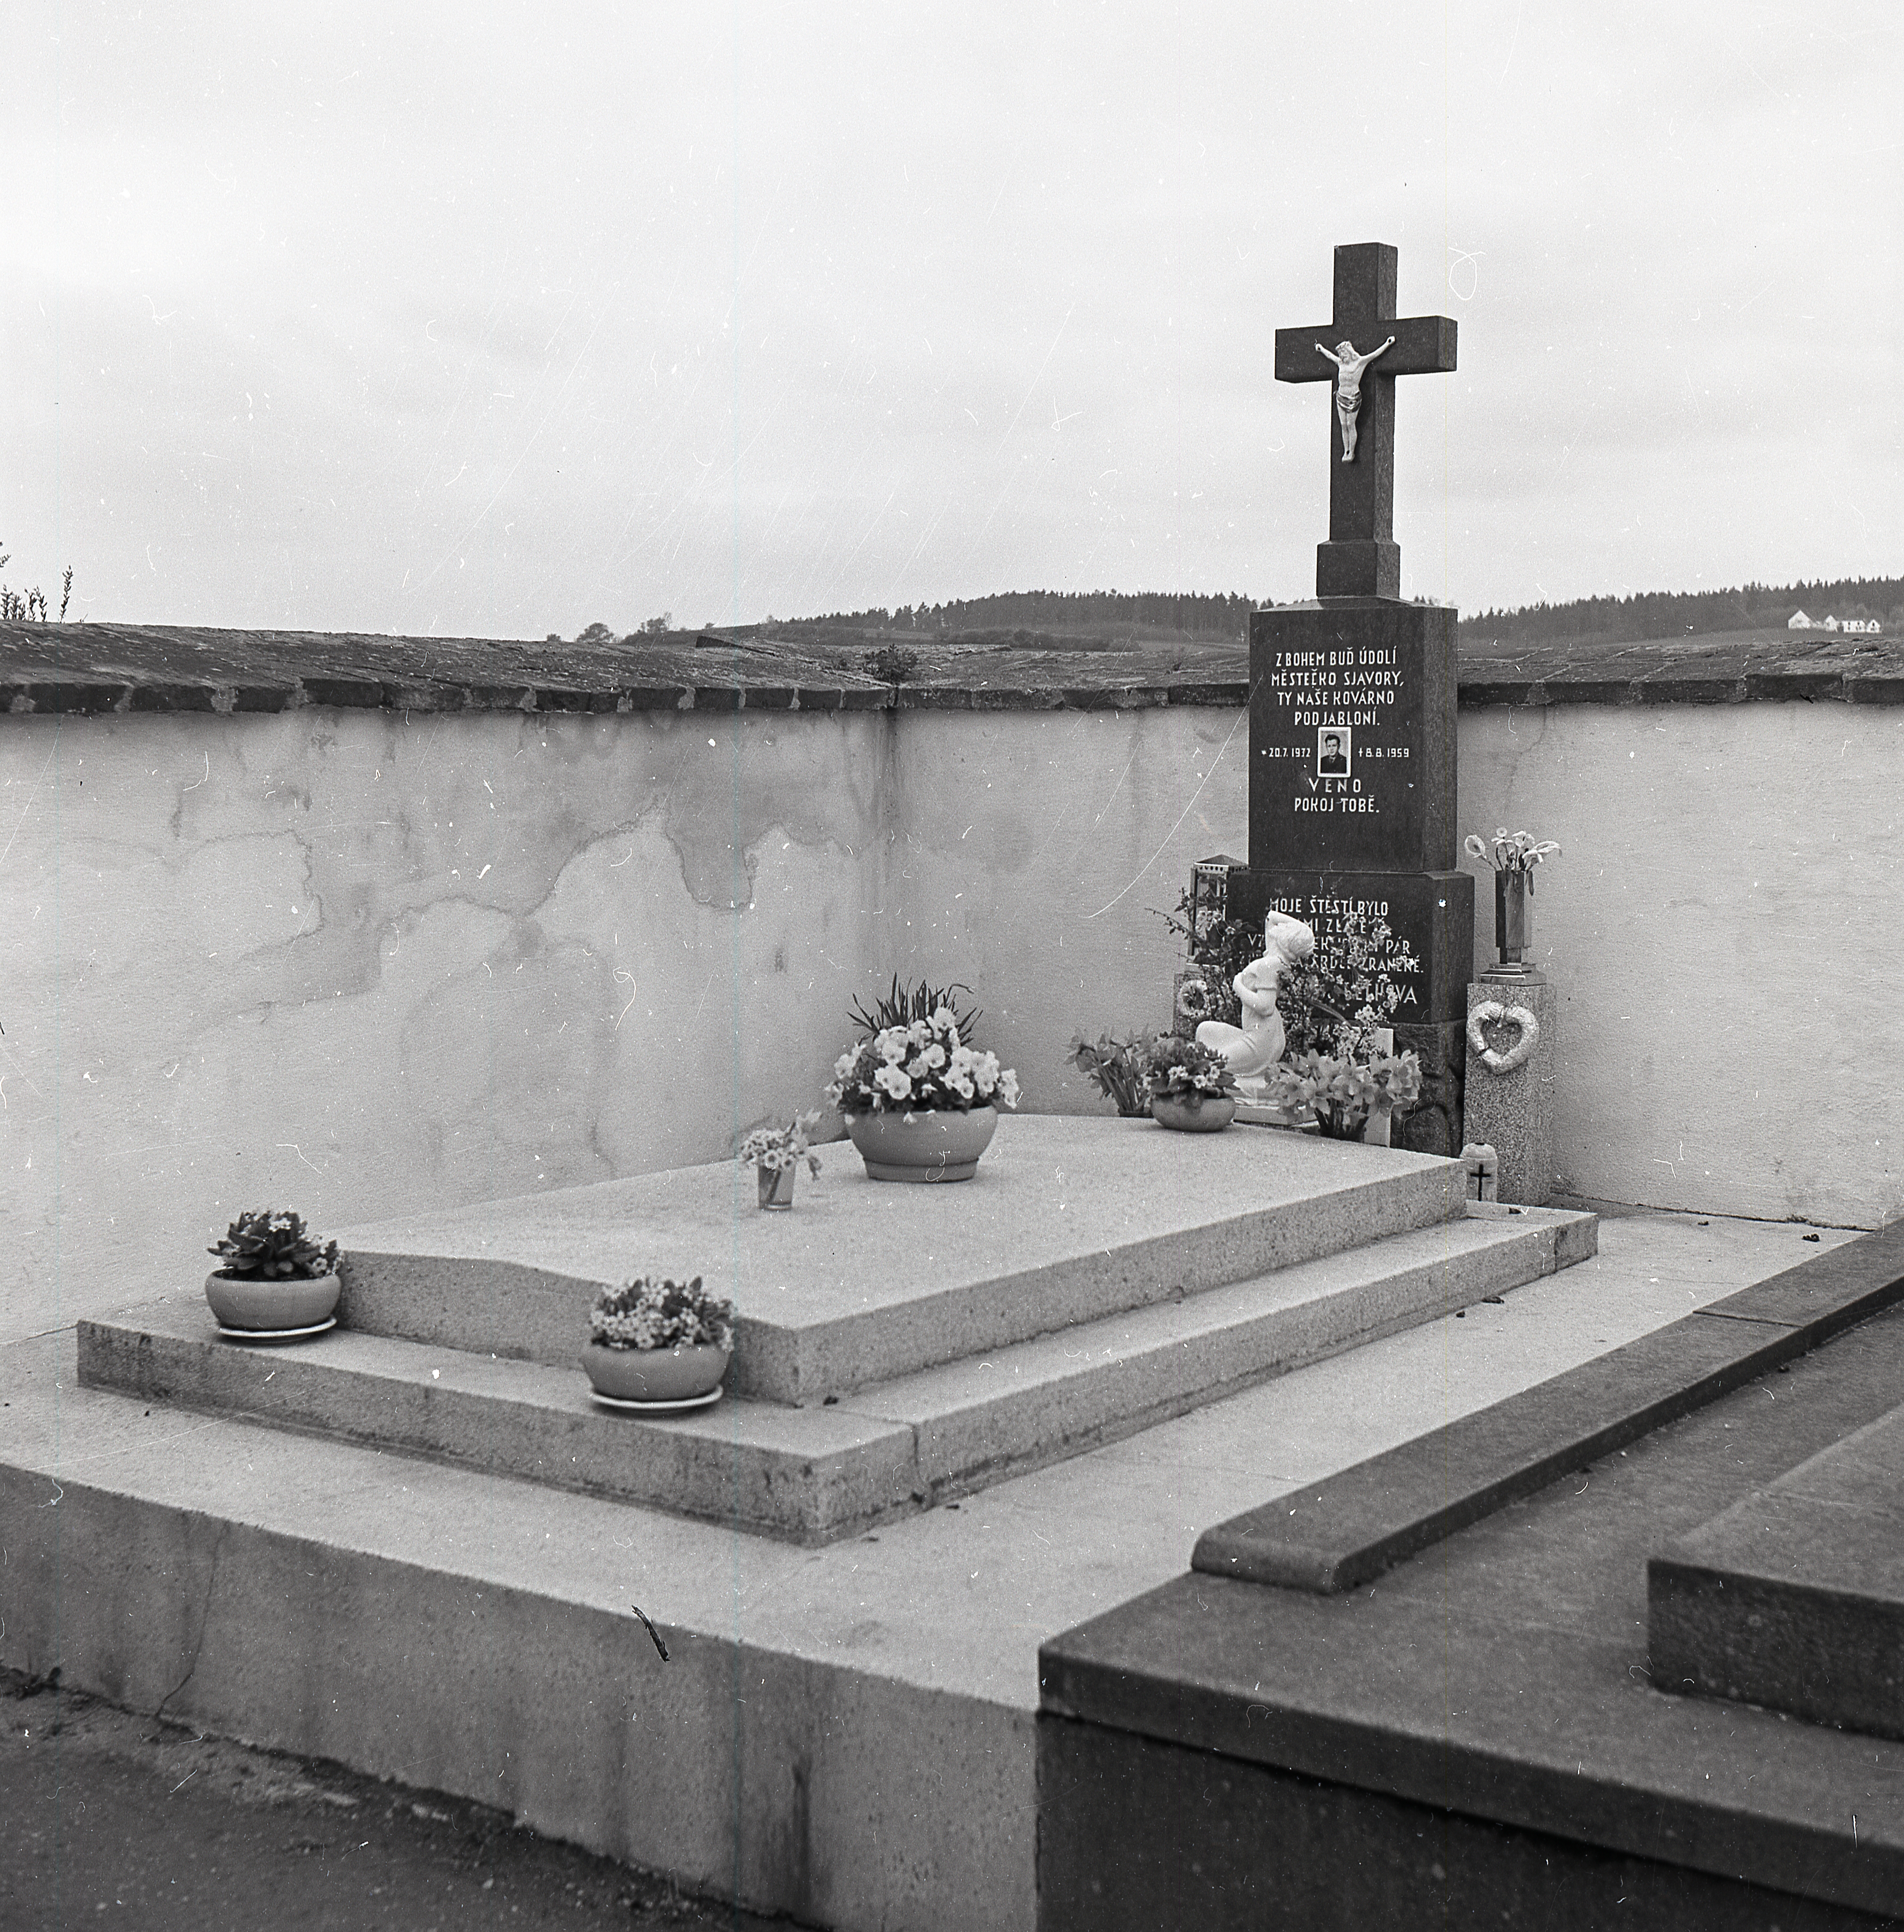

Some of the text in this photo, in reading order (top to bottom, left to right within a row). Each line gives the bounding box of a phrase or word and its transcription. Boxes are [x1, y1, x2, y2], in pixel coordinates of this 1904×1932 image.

[1330, 647, 1354, 666] BUĎ
[1359, 645, 1397, 665] ÚDOLÍ
[1271, 668, 1336, 686] MĚSTEČKO
[1277, 687, 1394, 705] TY NAŠE KOVÁRNO
[1308, 777, 1361, 793] VENO
[1295, 795, 1379, 813] POKOJ TOBĚ.
[1270, 898, 1302, 913] MOJE
[1358, 901, 1389, 916] BYLO
[1386, 936, 1410, 954] PÁR
